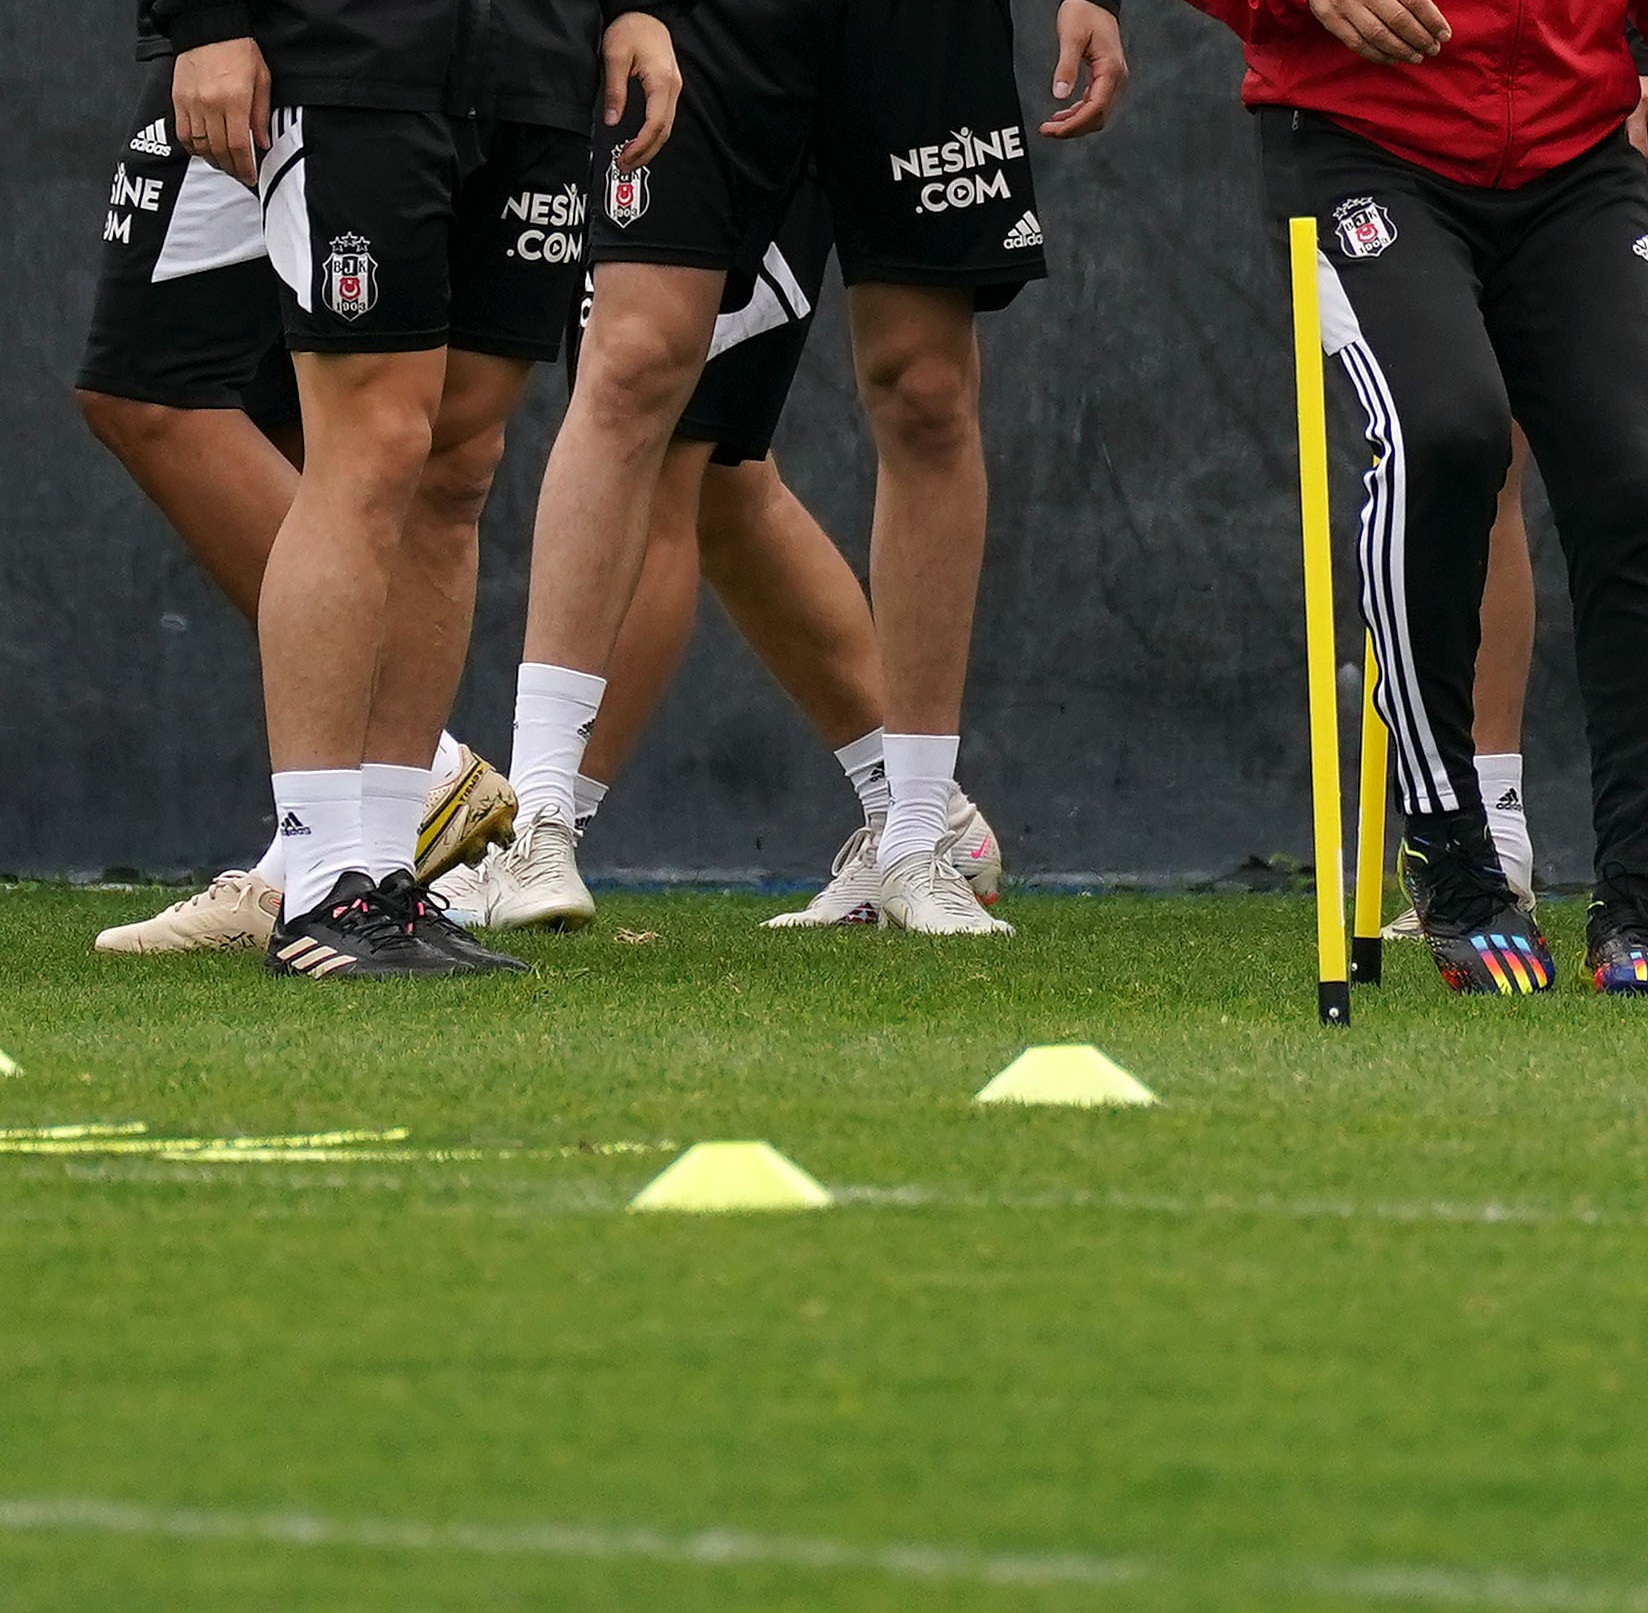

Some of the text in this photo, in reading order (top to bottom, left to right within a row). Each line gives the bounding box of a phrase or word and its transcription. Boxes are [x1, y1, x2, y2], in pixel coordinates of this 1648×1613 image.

[129, 138, 172, 157] adidas
[500, 182, 588, 227] NESIN
[914, 168, 1012, 214] .COM
[505, 228, 584, 264] .COM
[1002, 232, 1044, 250] adida
[334, 256, 369, 276] BJK
